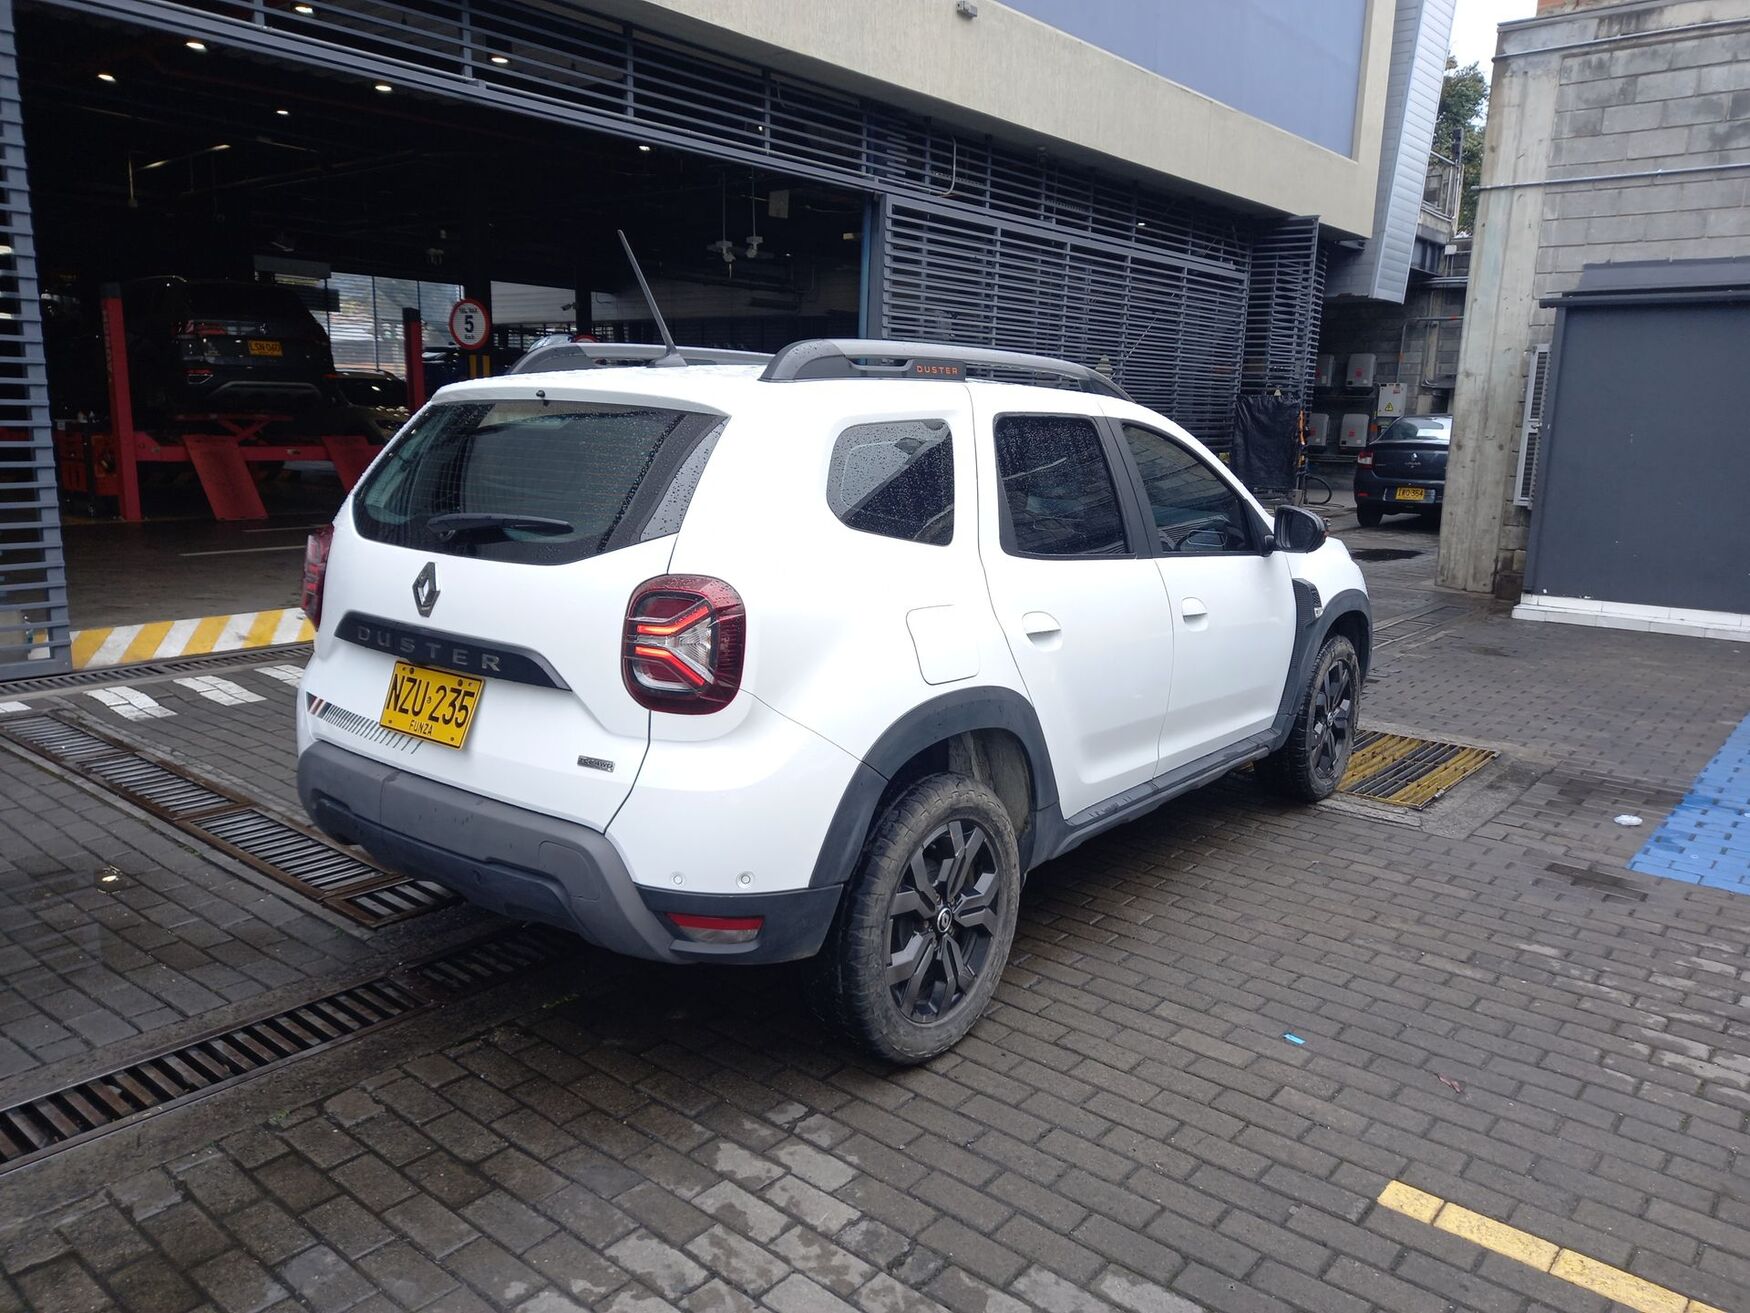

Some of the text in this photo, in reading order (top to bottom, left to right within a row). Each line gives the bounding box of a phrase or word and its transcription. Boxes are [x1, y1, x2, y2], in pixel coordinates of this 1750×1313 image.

[464, 315, 474, 333] 5
[916, 365, 958, 375] DUSTER
[357, 625, 500, 673] DUSTER
[409, 720, 433, 736] FUNZA
